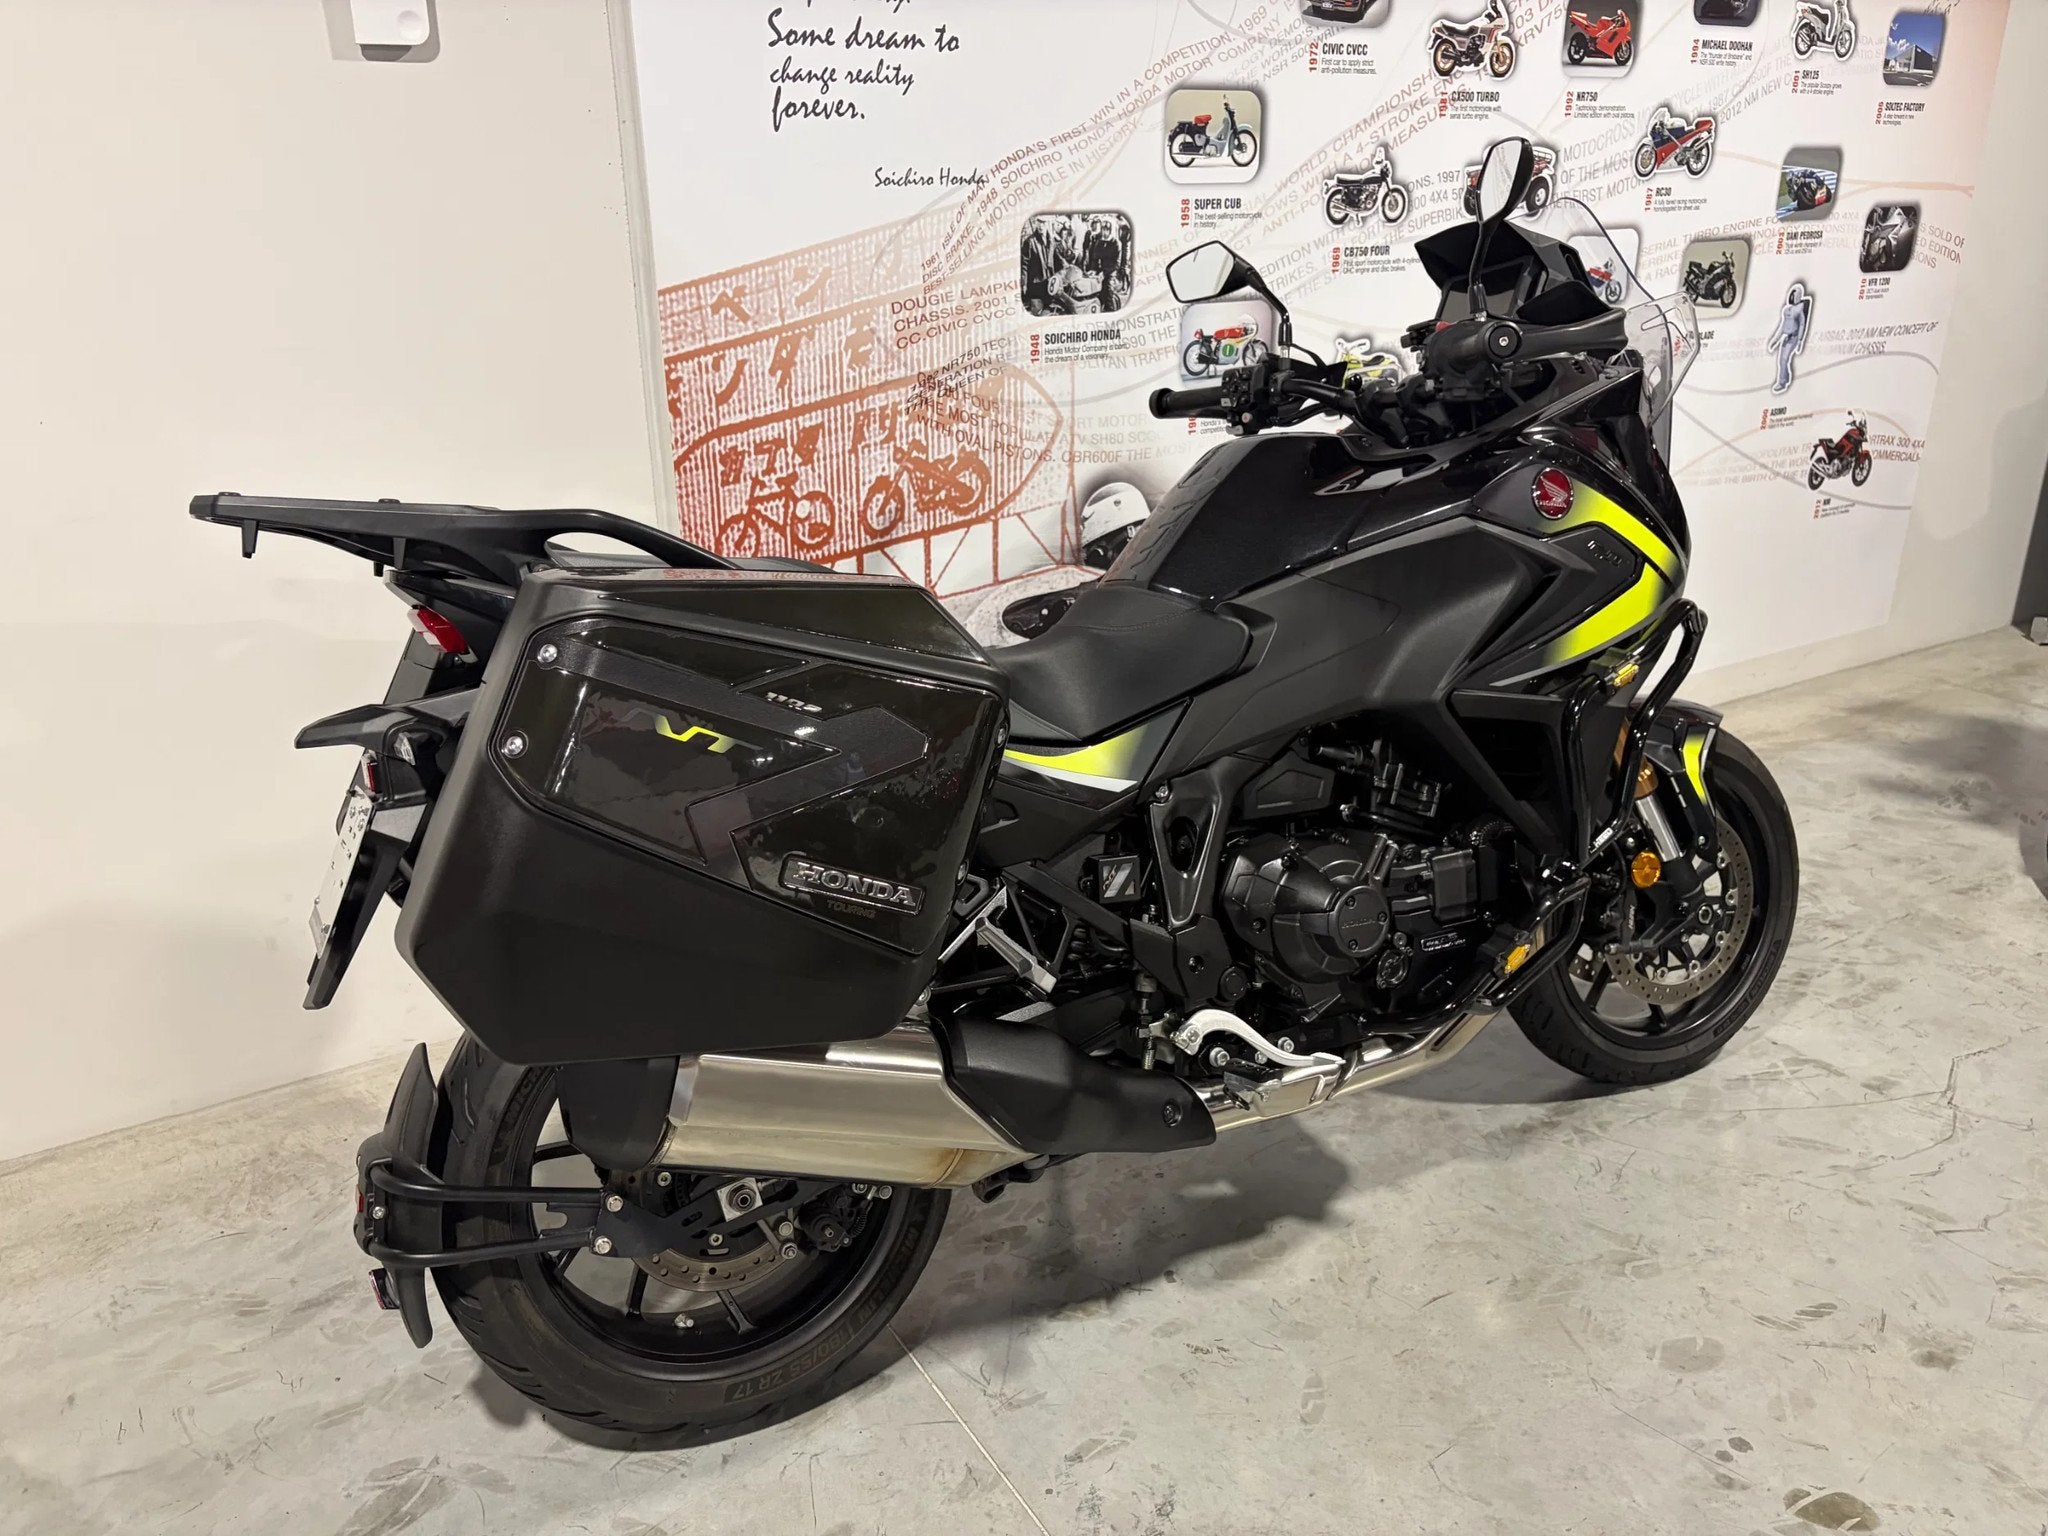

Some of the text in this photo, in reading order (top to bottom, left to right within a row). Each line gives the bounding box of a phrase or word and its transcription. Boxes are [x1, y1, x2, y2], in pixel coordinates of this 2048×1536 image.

[768, 7, 960, 52] Some dream to
[1308, 41, 1320, 73] 1972
[1322, 43, 1368, 56] CIVIC CVCC
[1702, 40, 1727, 50] MICHAEL
[770, 56, 914, 96] change reality
[1476, 91, 1500, 102] TURBO
[1576, 91, 1598, 101] NR750
[772, 86, 865, 132] forever.
[921, 255, 940, 271] 1961
[991, 141, 1047, 178] HONDA'S
[1050, 122, 1088, 146] FIRST
[1090, 103, 1115, 126] WIN
[1116, 86, 1132, 104] IN
[1134, 78, 1144, 92] A
[1144, 31, 1236, 82] COMPETITION.
[1238, 5, 1268, 35] 1969
[922, 261, 944, 284] DISC
[976, 188, 998, 217] 1948
[1000, 151, 1064, 191] SOICHIRO
[1067, 120, 1112, 152] HONDA
[1118, 84, 1162, 119] HONDA
[1165, 55, 1213, 87] MOTOR
[1217, 13, 1281, 63] COMPANY
[874, 167, 984, 188] Soichiro Honda
[1437, 170, 1461, 183] 1997
[985, 165, 1069, 227] MOTORCYCLE
[1070, 158, 1085, 175] IN
[1655, 187, 1671, 196] RC30
[1181, 198, 1190, 228] 1958
[1194, 198, 1241, 210] SUPER CUB
[1408, 206, 1464, 234] SUPERBIK
[1332, 247, 1340, 274] 1969
[1344, 246, 1390, 257] CB750 FOUR
[891, 278, 1019, 315] DOUGIE LAMPKI
[893, 296, 1008, 333] CHASSIS. 2001
[972, 307, 1016, 325] CVCC
[1044, 329, 1121, 345] SOICHIRO HONDA
[1149, 324, 1177, 343] THE
[1030, 333, 1040, 364] 1948
[1044, 347, 1063, 355] Honda
[1064, 346, 1081, 354] Motor
[792, 861, 916, 907] HONDA
[826, 899, 877, 918] TOURING
